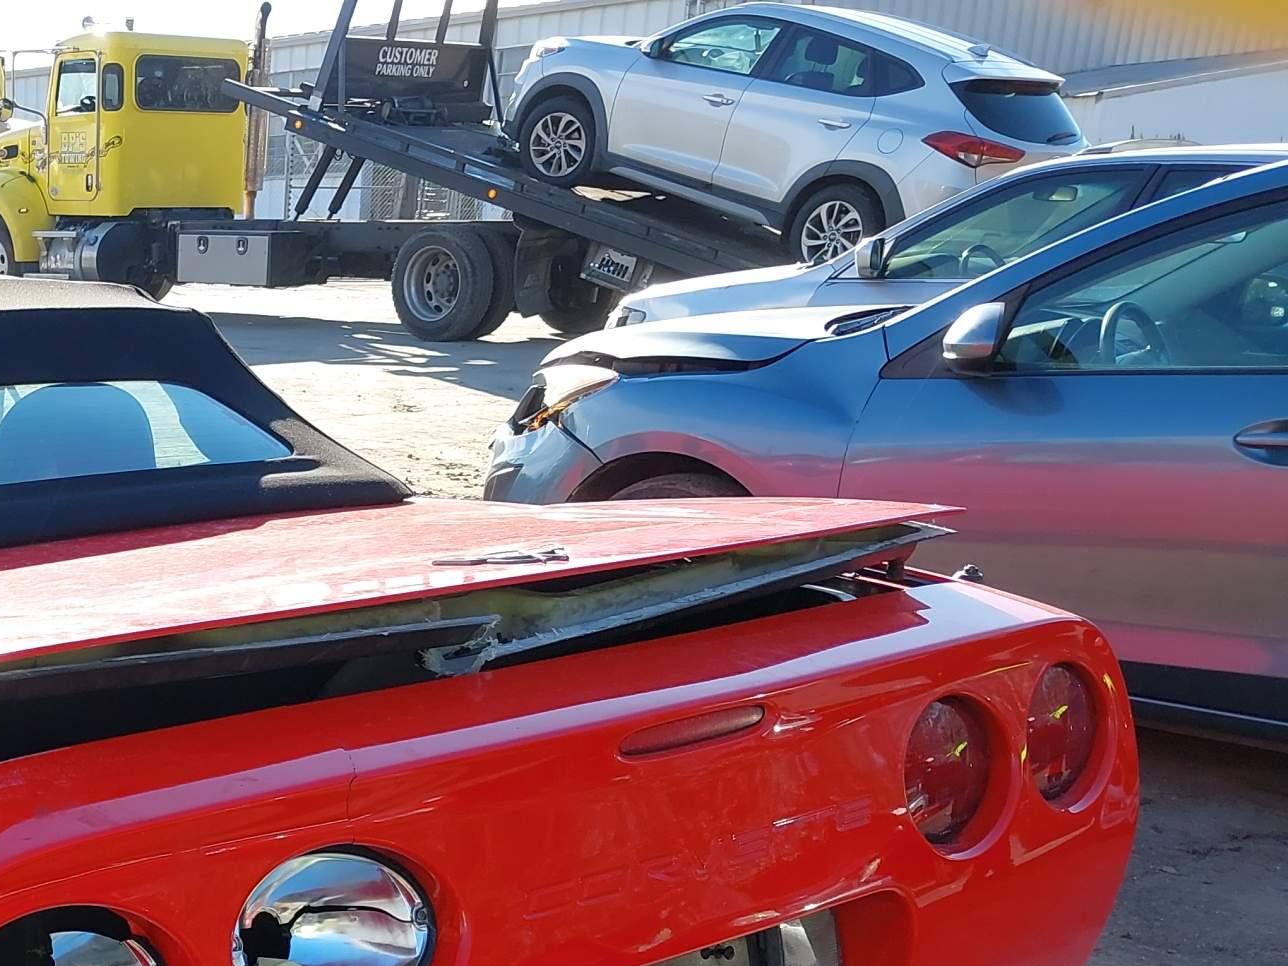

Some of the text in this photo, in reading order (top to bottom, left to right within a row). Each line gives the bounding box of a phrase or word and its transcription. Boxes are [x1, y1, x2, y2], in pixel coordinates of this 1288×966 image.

[379, 47, 438, 65] CUSTOMER
[375, 63, 435, 77] PARKING ONLY
[61, 153, 86, 164] TOWING
